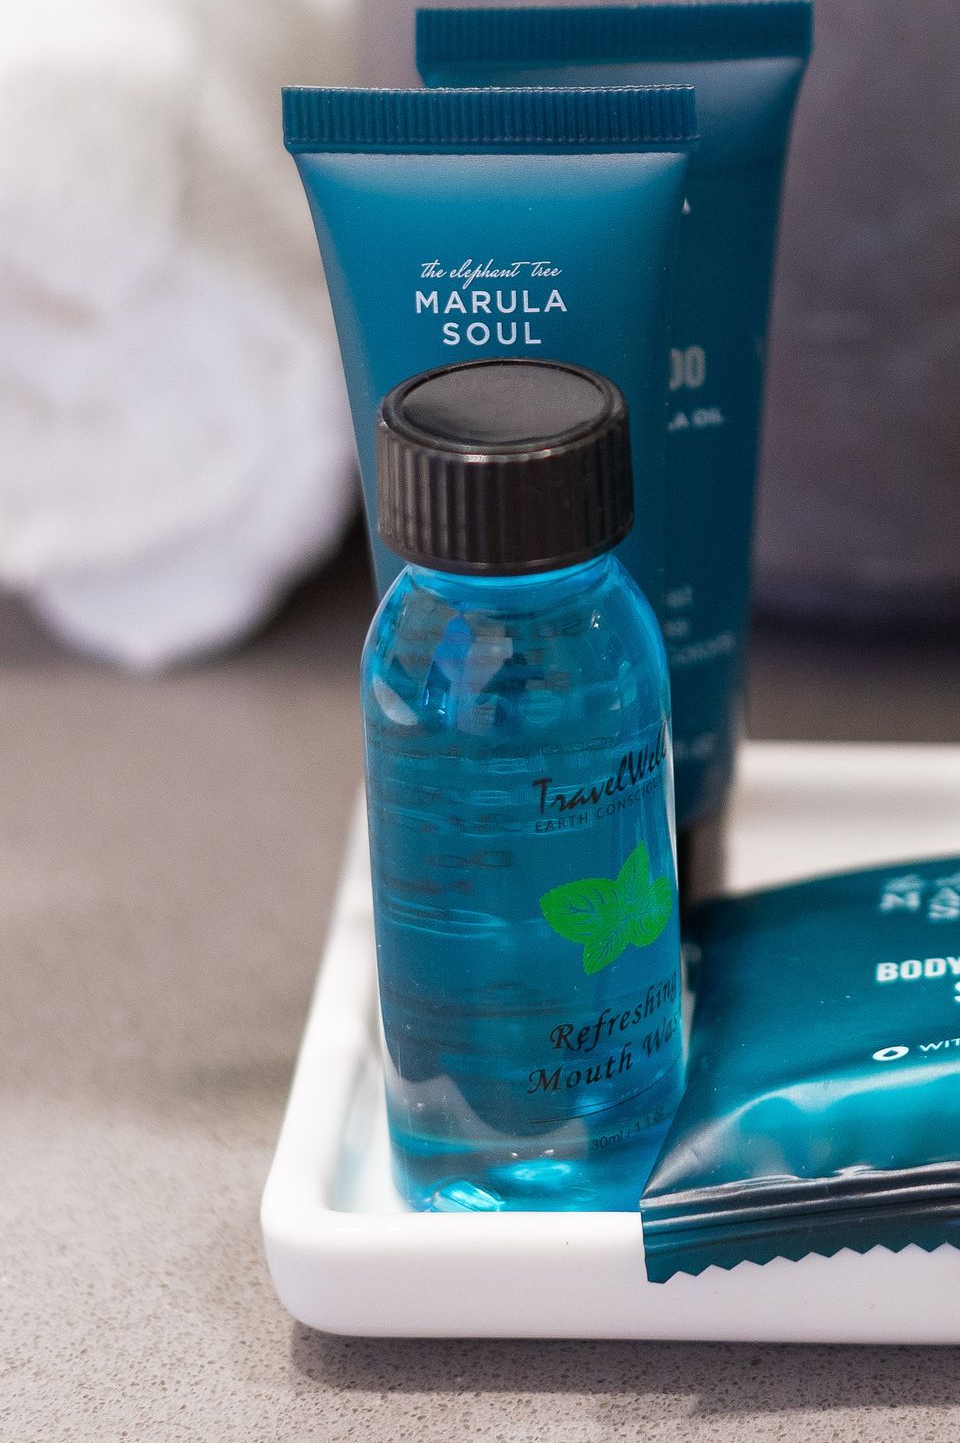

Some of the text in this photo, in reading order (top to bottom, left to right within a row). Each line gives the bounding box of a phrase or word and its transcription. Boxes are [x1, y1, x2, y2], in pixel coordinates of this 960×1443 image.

[421, 259, 448, 278] the
[449, 258, 531, 290] elephant
[415, 289, 568, 314] MARULA
[442, 321, 542, 346] SOUL
[535, 813, 588, 833] EARTH
[550, 969, 677, 1053] Refreshing
[527, 1041, 634, 1095] Mouth
